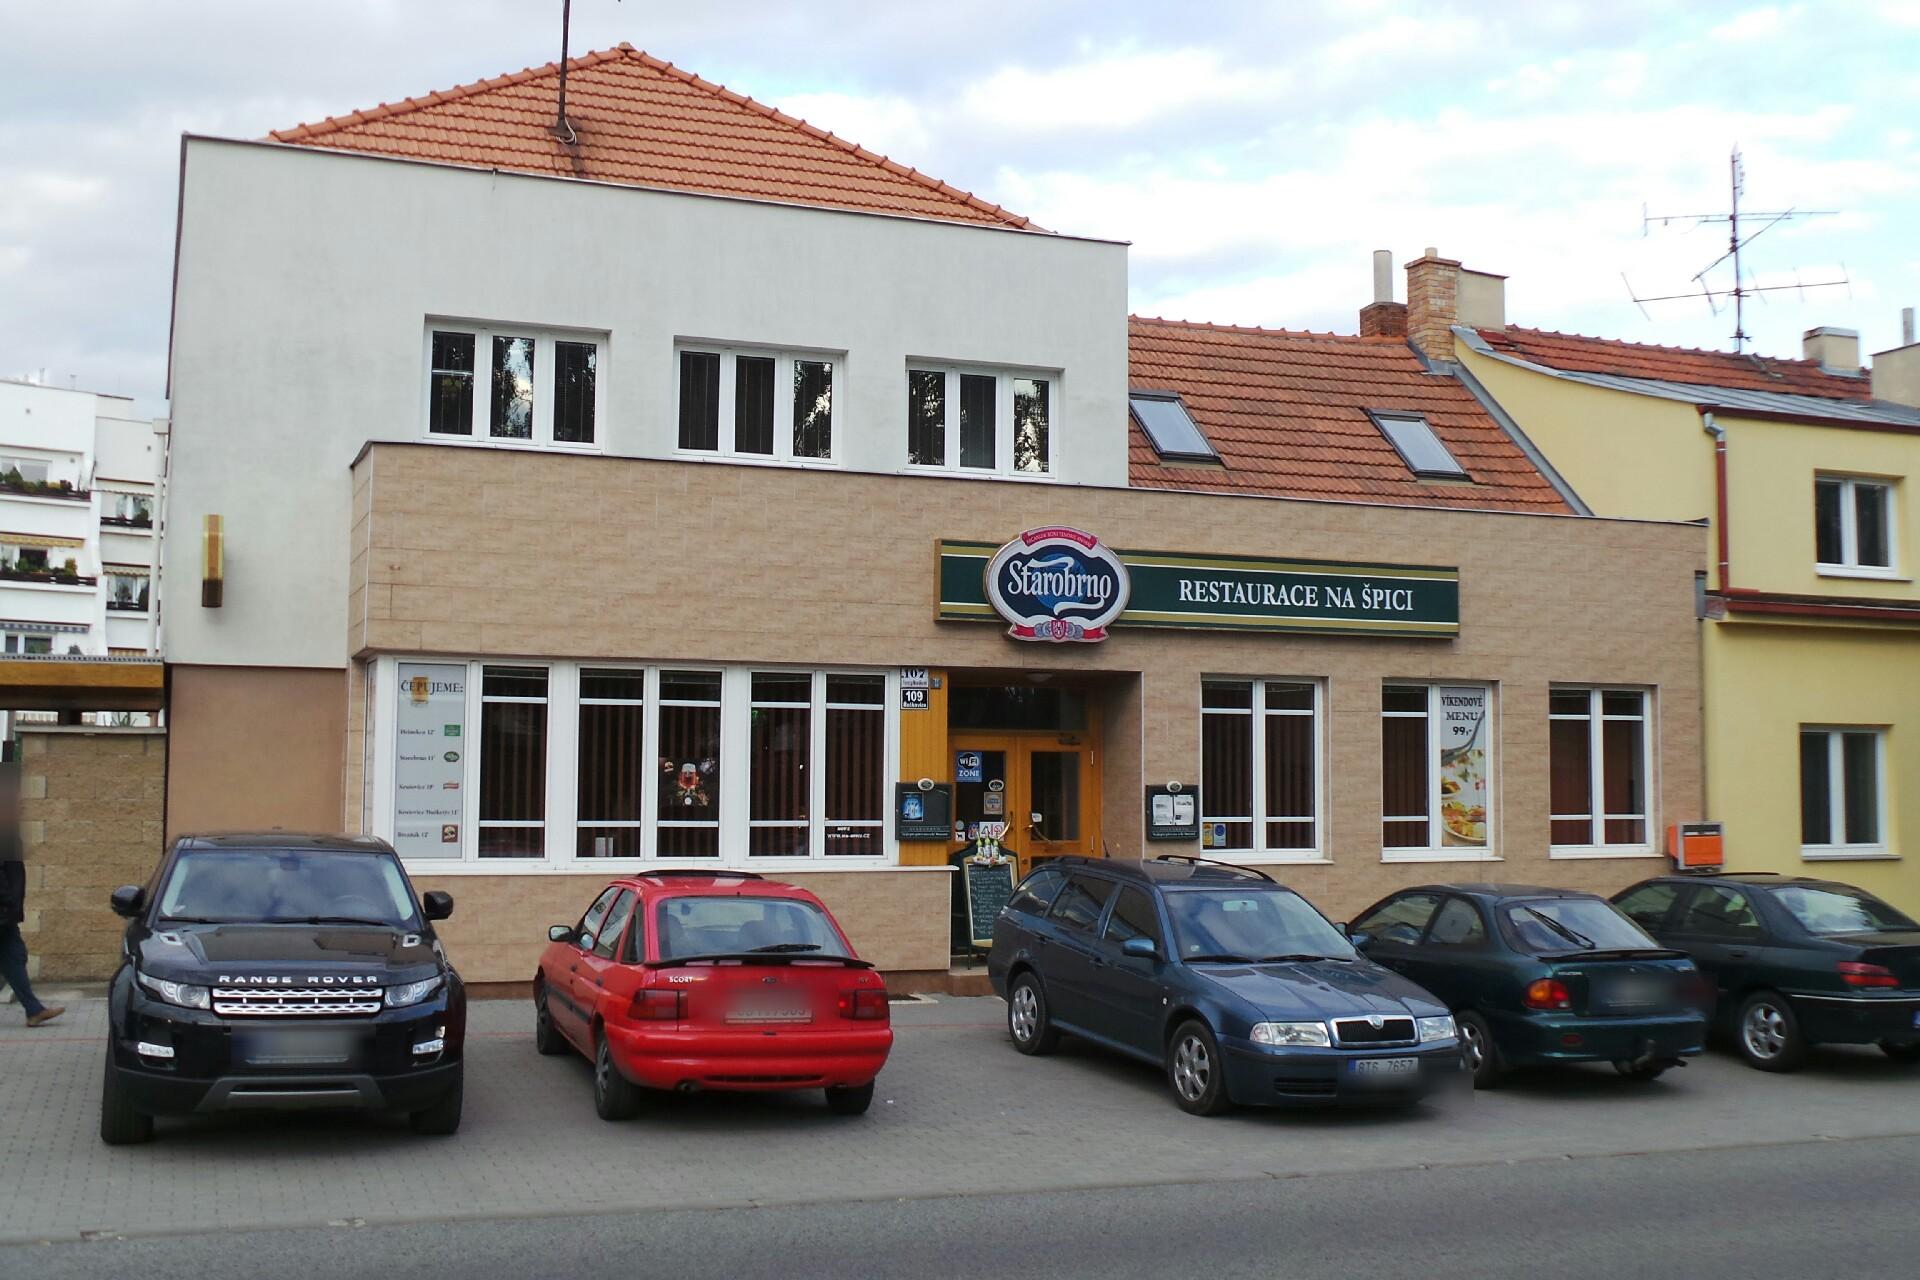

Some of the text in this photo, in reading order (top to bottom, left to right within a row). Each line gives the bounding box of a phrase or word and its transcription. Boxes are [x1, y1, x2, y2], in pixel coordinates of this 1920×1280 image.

[1007, 556, 1112, 615] Starobrno
[1179, 579, 1414, 611] RESTAURACE NA ŠPICI
[905, 691, 923, 702] 109
[1441, 694, 1483, 707] VÍKENDOVÉ
[1446, 711, 1479, 721] MENU
[958, 769, 980, 777] ZONE
[218, 975, 378, 984] RANGE ROVER
